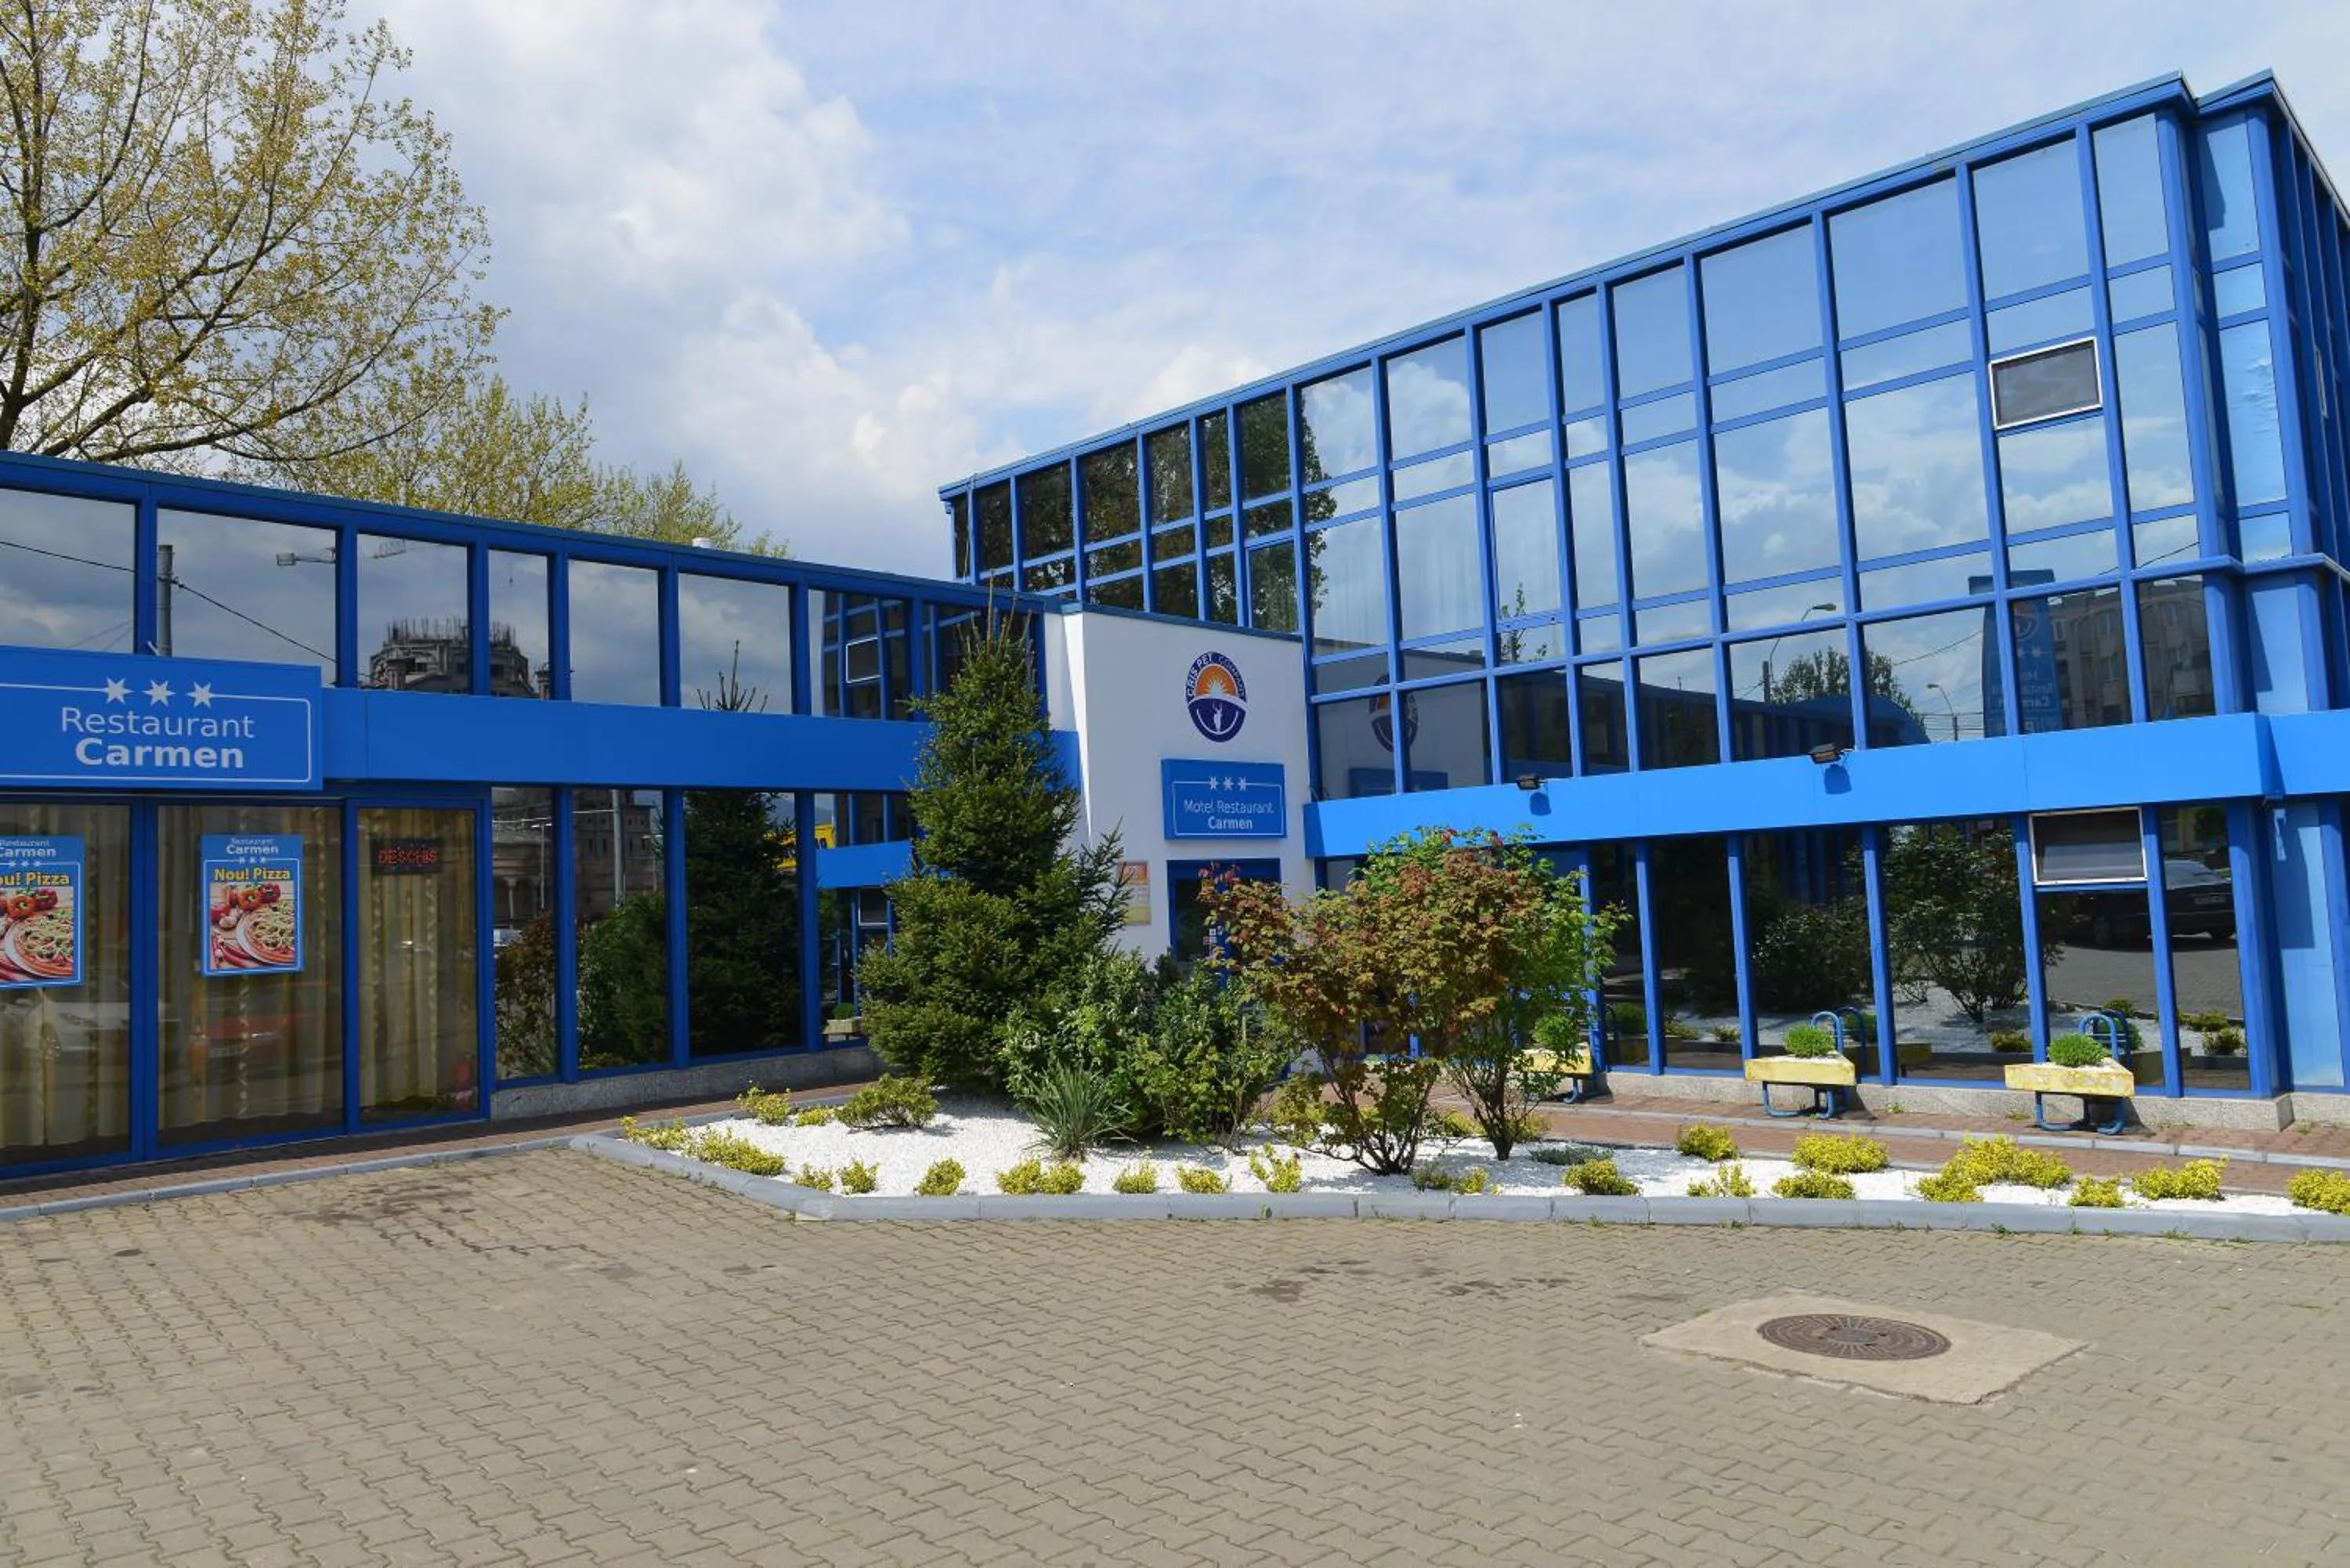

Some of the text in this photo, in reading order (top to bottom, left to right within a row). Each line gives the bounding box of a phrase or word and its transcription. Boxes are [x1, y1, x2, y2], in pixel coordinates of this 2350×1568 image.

[1196, 653, 1213, 668] PET
[61, 706, 256, 739] Restaurant
[75, 737, 244, 768] Carmen
[1184, 799, 1275, 814] Motel Restaurant
[1207, 815, 1253, 830] Carmen
[225, 844, 279, 854] Carmen
[25, 871, 70, 886] Pizza
[214, 867, 291, 881] Nou! Pizza
